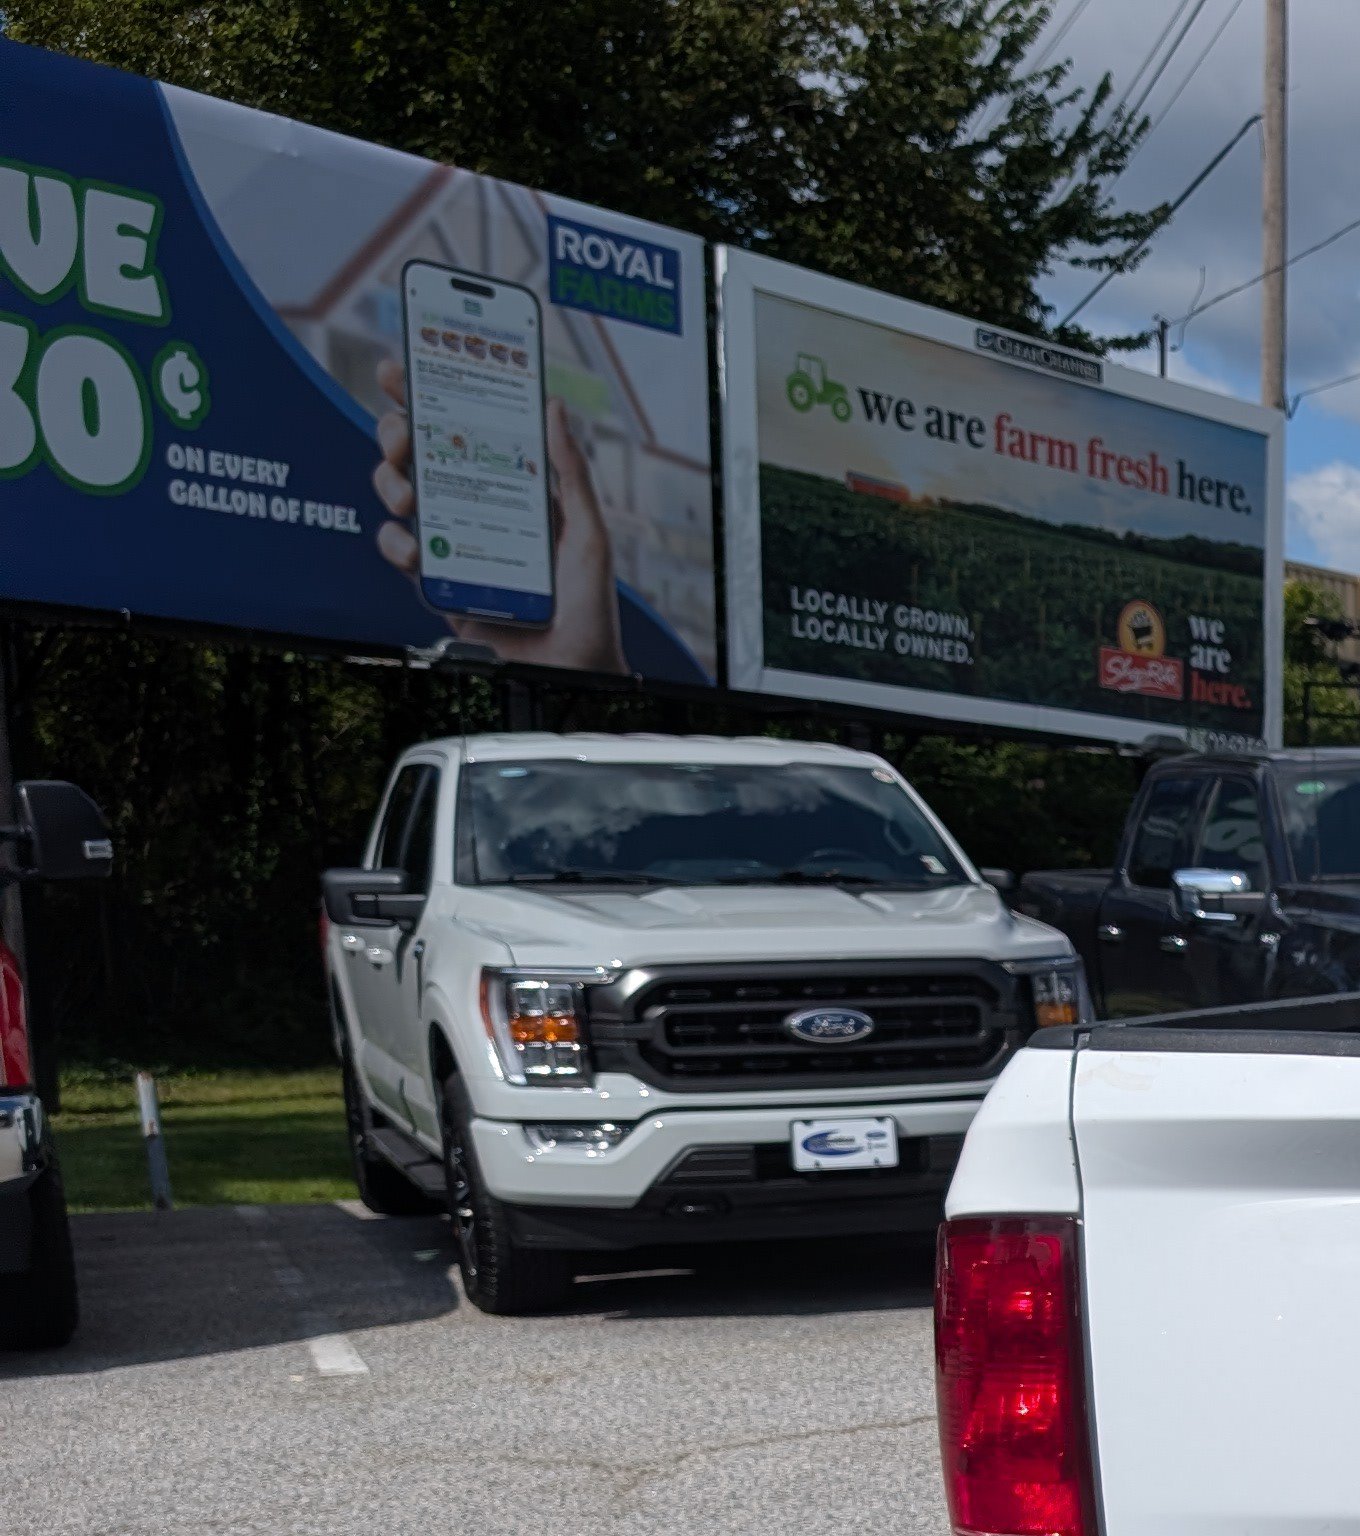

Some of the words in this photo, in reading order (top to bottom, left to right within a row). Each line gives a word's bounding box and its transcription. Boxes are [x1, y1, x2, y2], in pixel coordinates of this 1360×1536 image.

[556, 225, 675, 290] ROYAL
[556, 266, 676, 326] FARMS
[167, 443, 206, 474] ON
[209, 450, 290, 488] EVERY
[857, 385, 914, 432] we
[924, 404, 985, 449] are
[993, 412, 1079, 473] farm
[1087, 436, 1169, 496] fresh
[1176, 457, 1252, 516] here.
[169, 478, 267, 519] GALLON
[269, 495, 301, 524] OF
[303, 501, 362, 534] FUEL
[789, 586, 889, 625] LOCALLY
[893, 603, 976, 643] GROWN,
[789, 612, 890, 651] LOCALLY
[893, 630, 975, 666] OWNED.
[1188, 614, 1226, 645] we
[1188, 643, 1232, 674] are
[1191, 669, 1252, 709] here.
